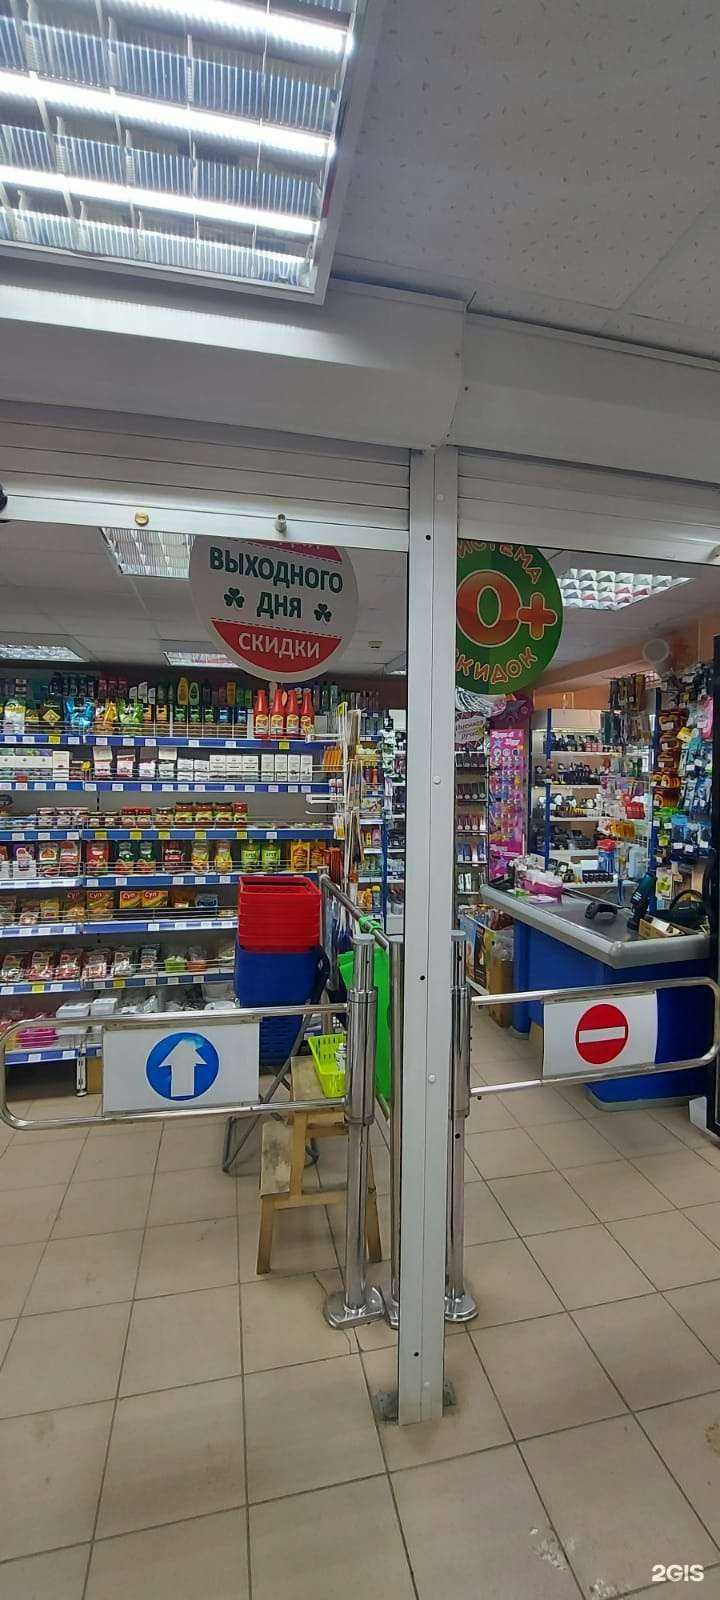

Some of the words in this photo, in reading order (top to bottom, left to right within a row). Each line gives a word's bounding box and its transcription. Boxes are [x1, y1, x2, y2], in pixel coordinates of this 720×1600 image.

[209, 546, 344, 593] ВЫХОДНОГО
[456, 540, 543, 585] ИСЕМА
[256, 591, 302, 619] ДНЯ
[238, 632, 320, 660] СКИДКИ
[456, 646, 538, 685] КИДОК
